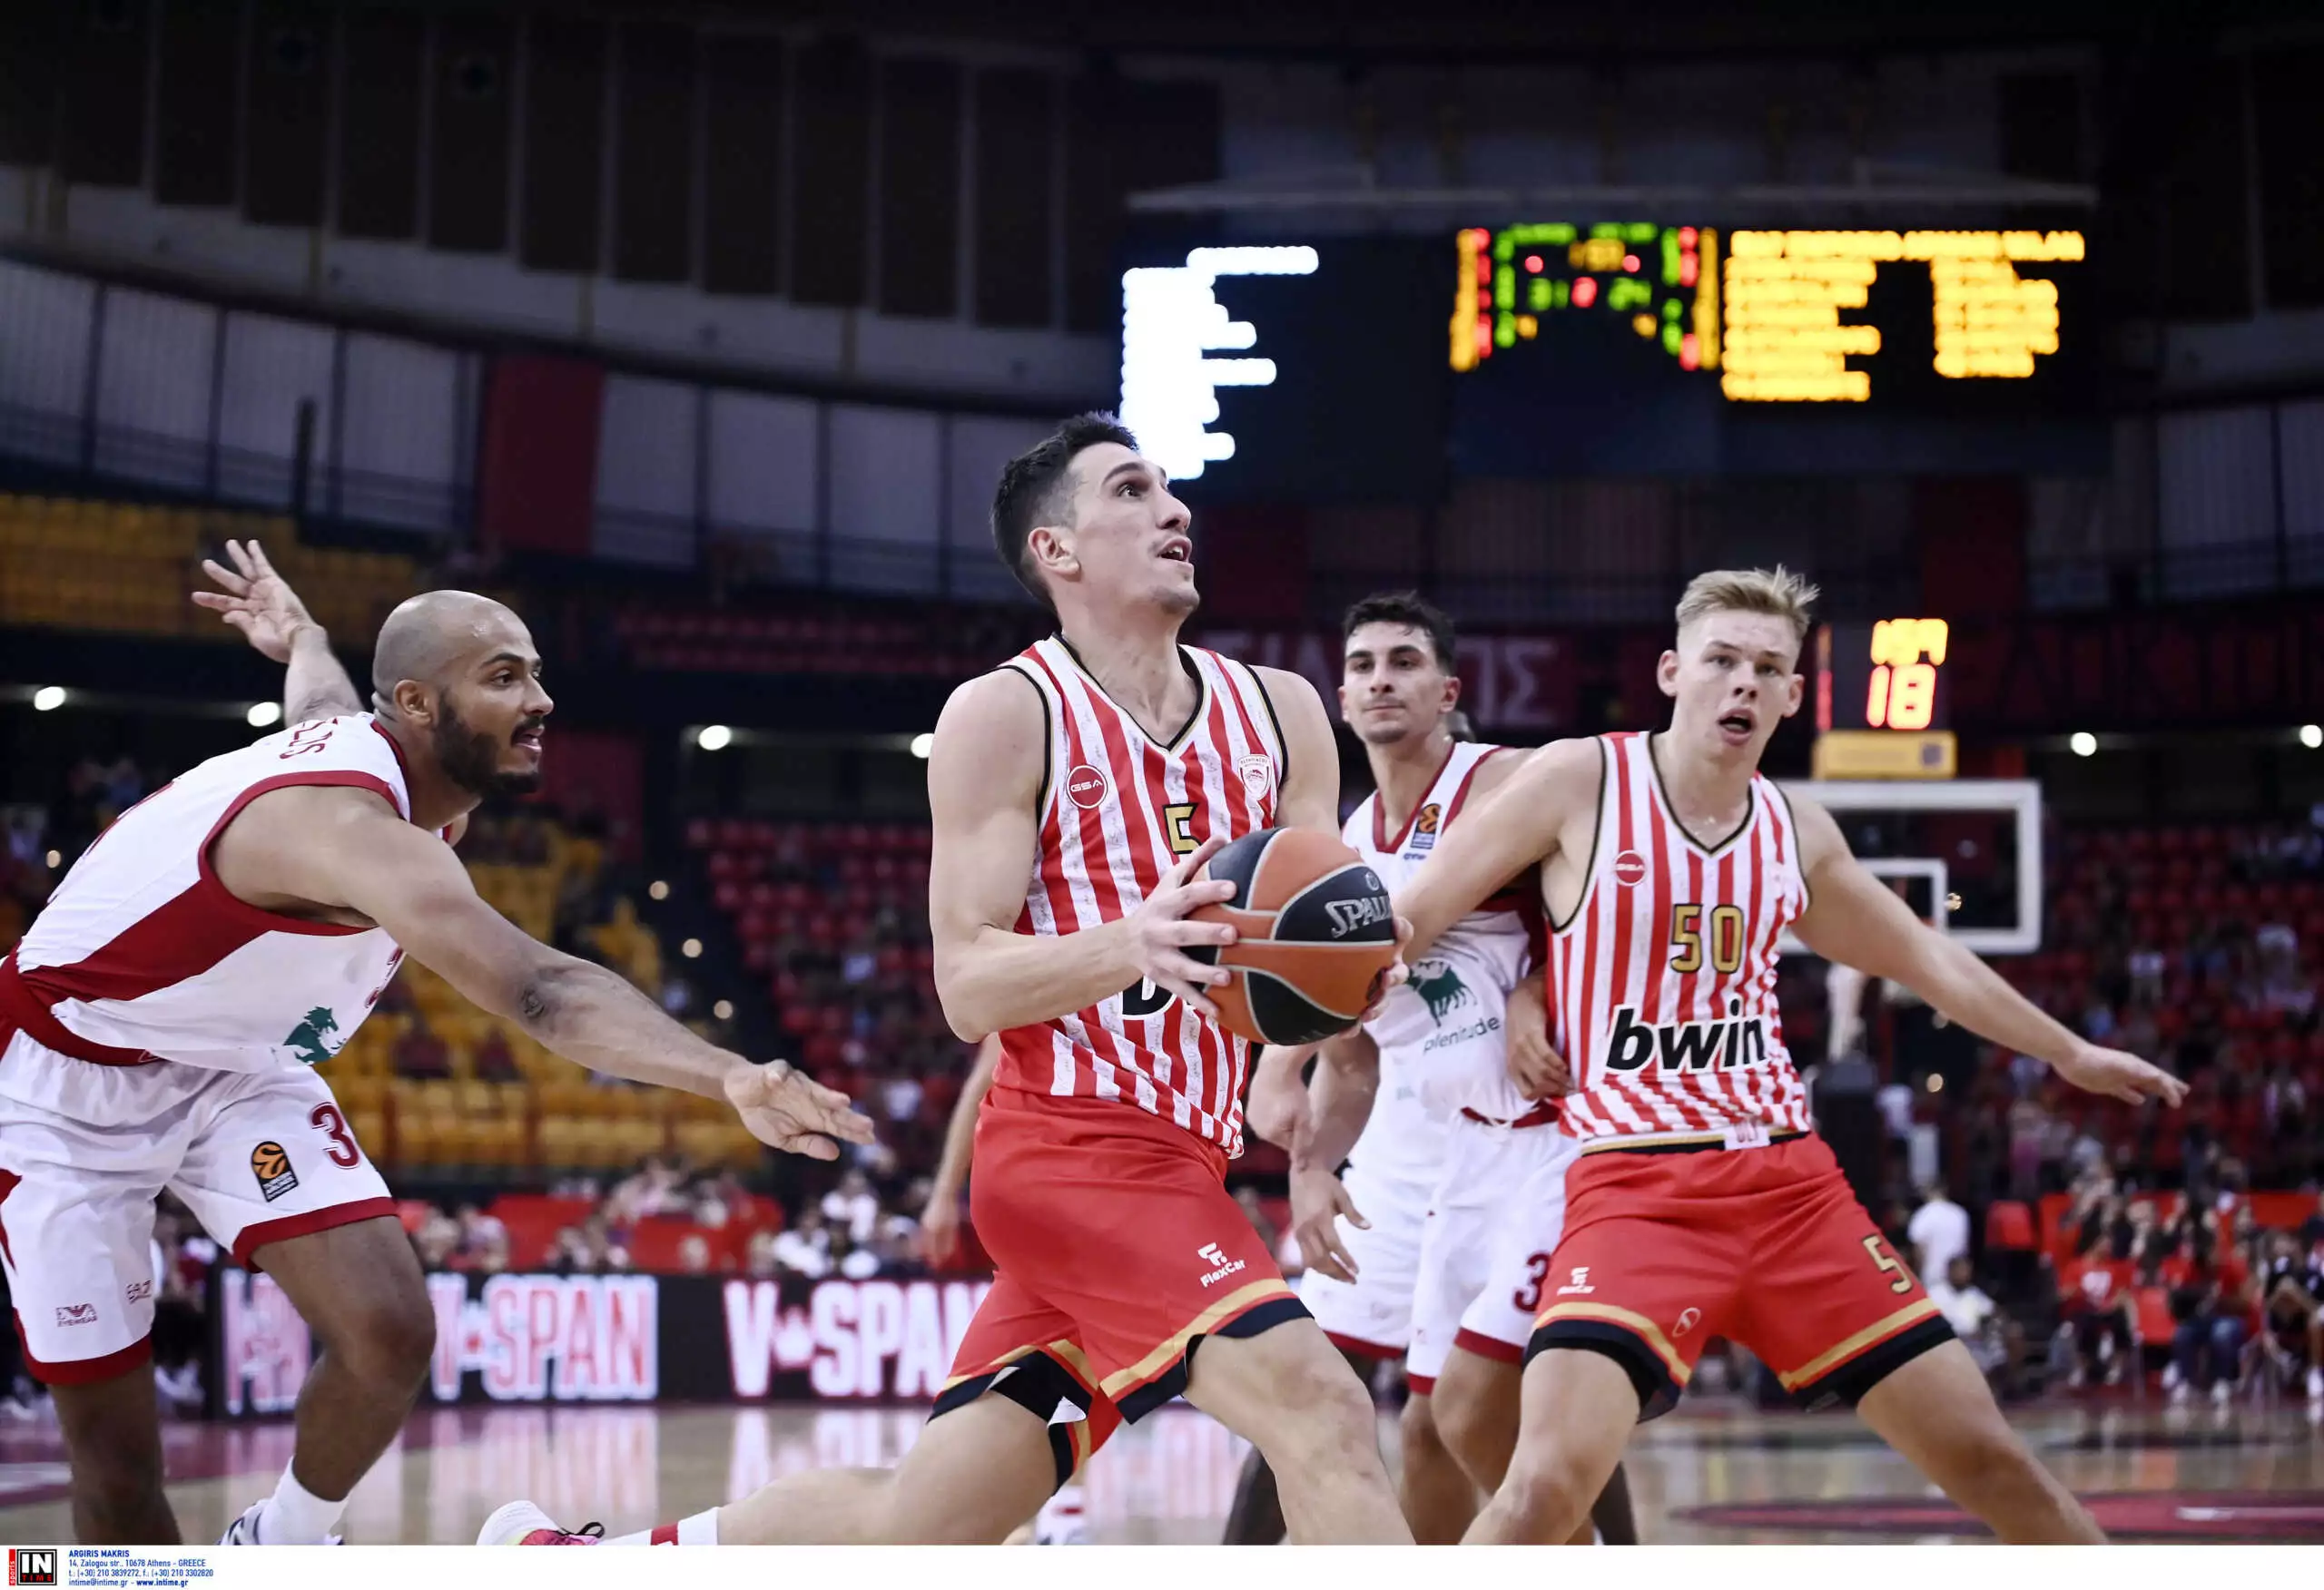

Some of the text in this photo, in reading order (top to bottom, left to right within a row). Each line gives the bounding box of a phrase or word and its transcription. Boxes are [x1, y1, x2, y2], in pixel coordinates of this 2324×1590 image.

[1866, 663, 1936, 730] 18
[1070, 779, 1103, 792] GSA
[1162, 802, 1202, 855] 5
[1669, 903, 1744, 974] 50
[1605, 997, 1768, 1071] bwin
[309, 1101, 359, 1170] 3
[1199, 1259, 1246, 1288] FlexCar
[1512, 1252, 1551, 1313] 3
[1861, 1233, 1914, 1295] 5
